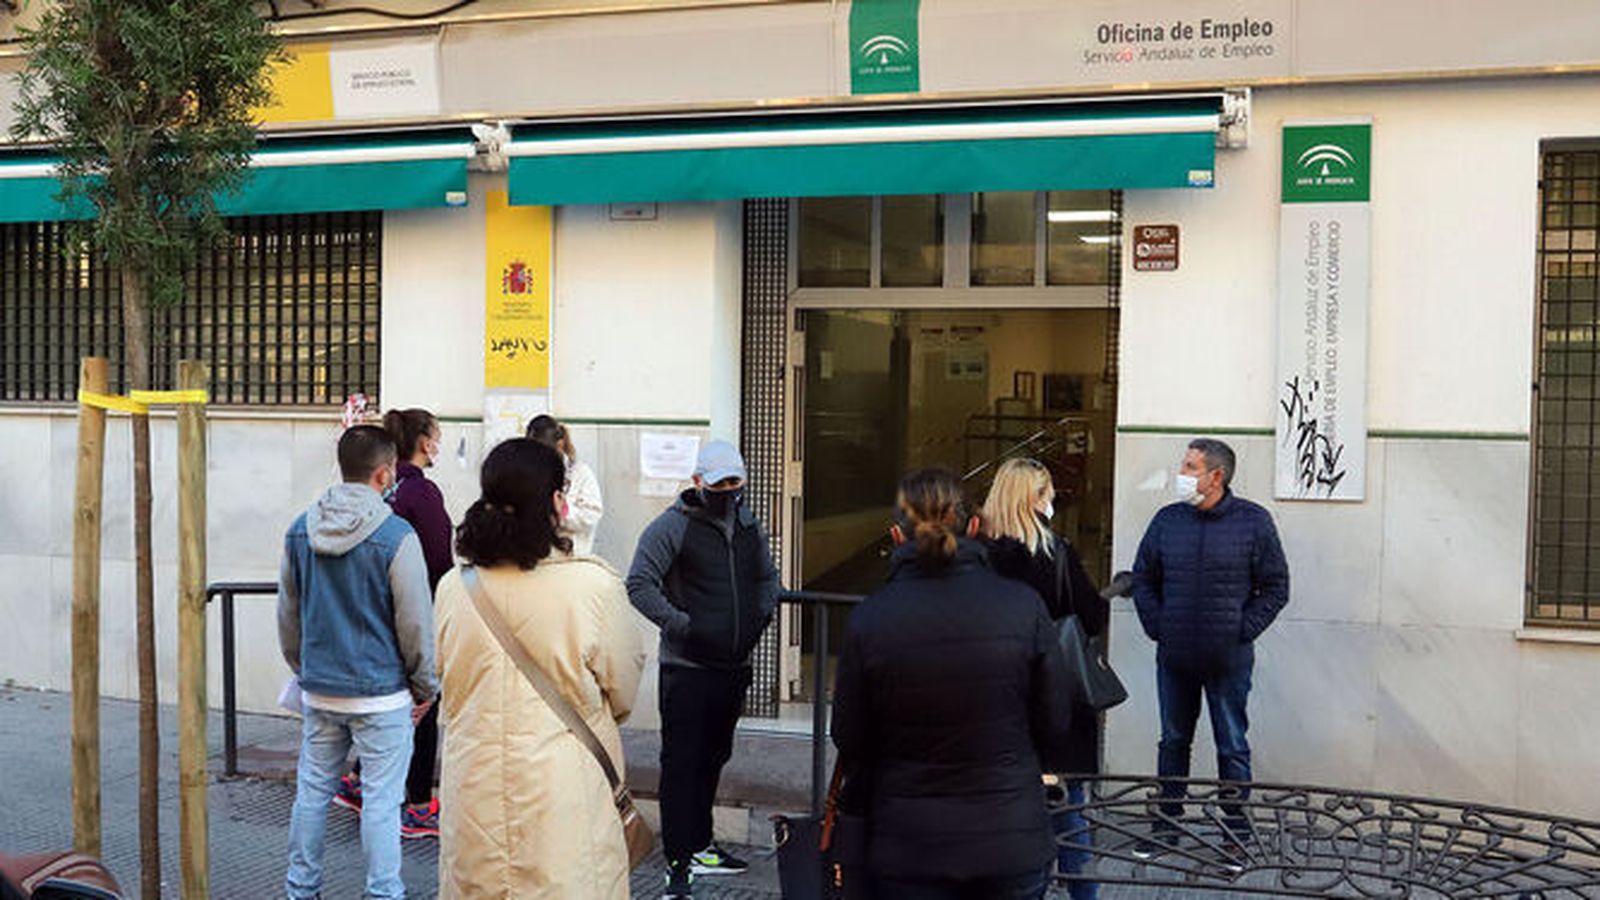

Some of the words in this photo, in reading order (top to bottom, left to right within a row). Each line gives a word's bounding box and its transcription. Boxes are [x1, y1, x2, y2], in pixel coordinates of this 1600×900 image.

[1097, 23, 1165, 45] Oficina
[1170, 21, 1194, 41] de
[1200, 18, 1274, 42] Empleo
[1083, 49, 1133, 64] Servicio
[1138, 47, 1195, 62] Andaluz
[1199, 45, 1215, 59] de
[1222, 42, 1275, 60] Empleo
[1304, 220, 1322, 267] Empleo
[1326, 220, 1341, 281] COMERCIO
[1307, 269, 1320, 286] de
[1326, 282, 1339, 291] Y
[1304, 288, 1319, 335] Andaluz
[1326, 292, 1339, 344] EMPRESA
[1303, 339, 1318, 384] Servicio
[1324, 397, 1337, 412] DE
